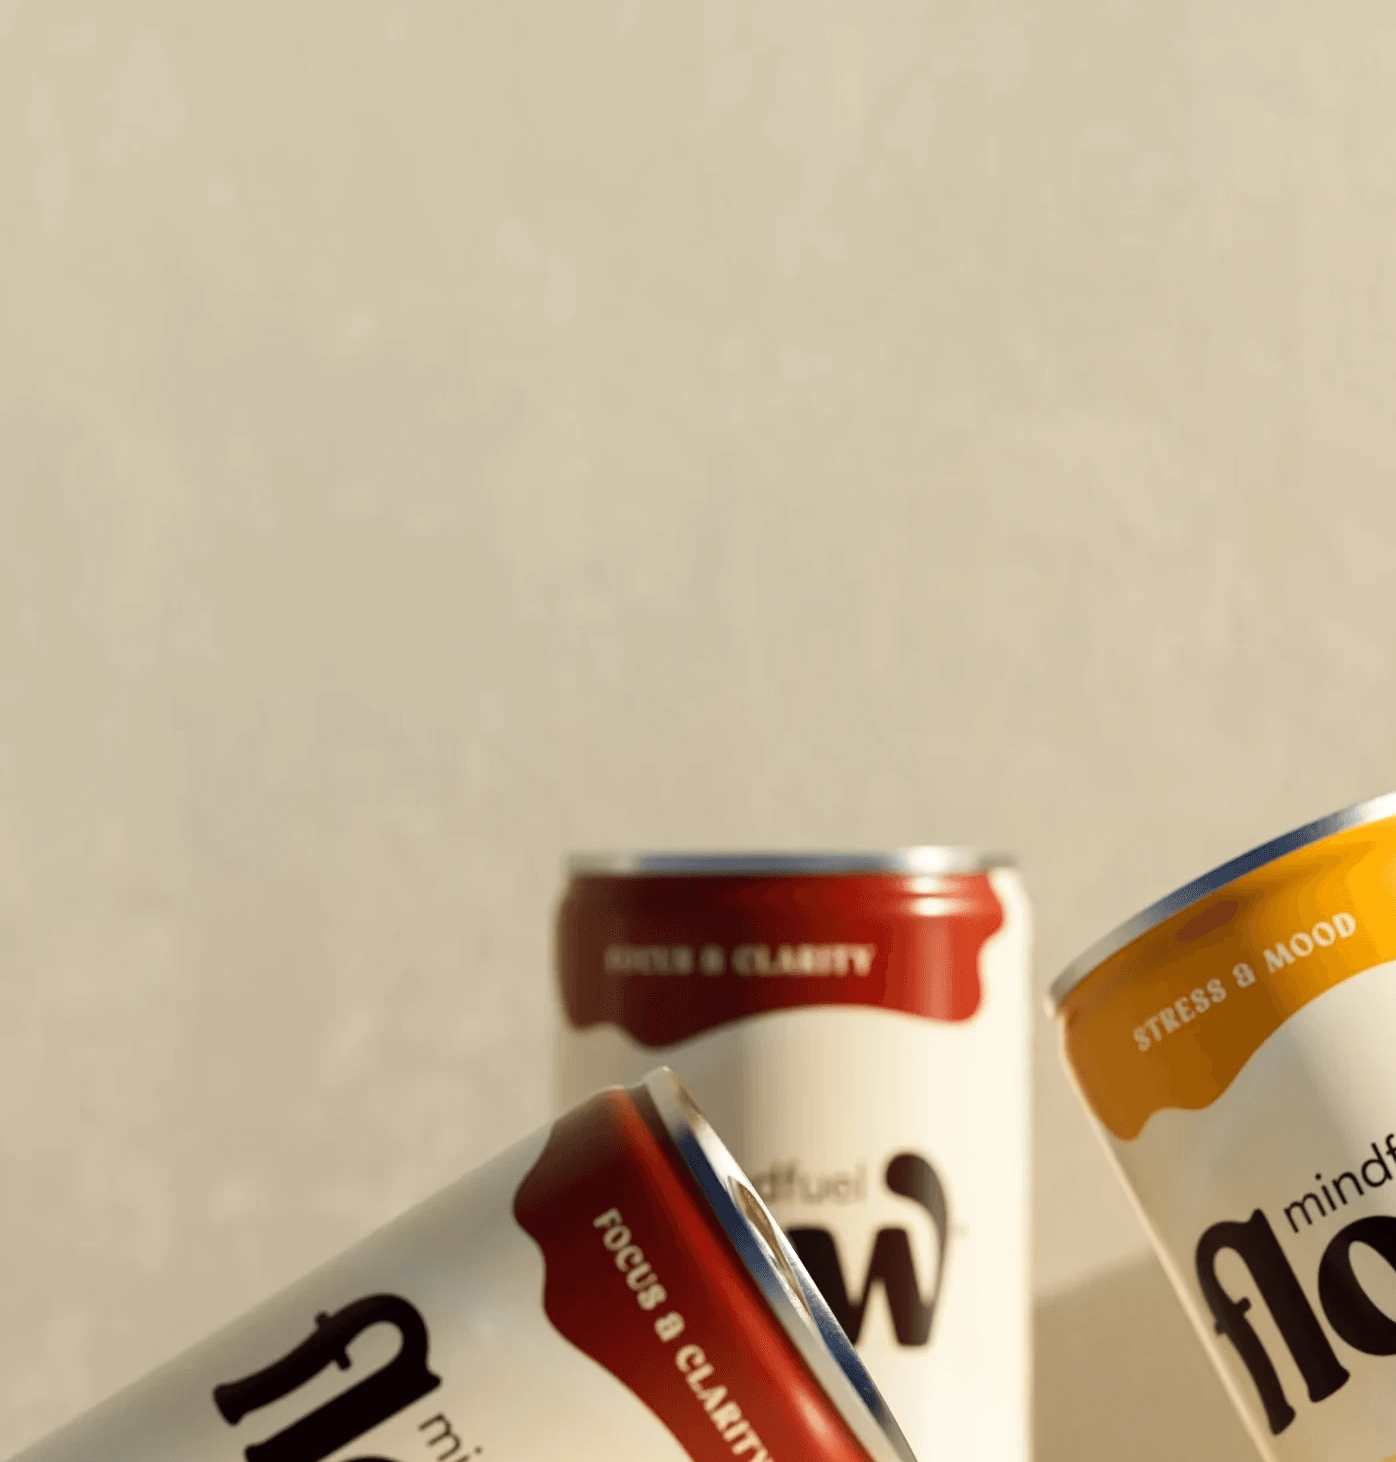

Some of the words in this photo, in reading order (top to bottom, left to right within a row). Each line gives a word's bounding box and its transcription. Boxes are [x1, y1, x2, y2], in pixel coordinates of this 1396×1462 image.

[1132, 976, 1228, 1051] STRESS
[1233, 962, 1257, 988] &
[1263, 911, 1357, 974] MOOD
[750, 1160, 867, 1203] dfuel
[592, 1207, 668, 1311] FOCUS
